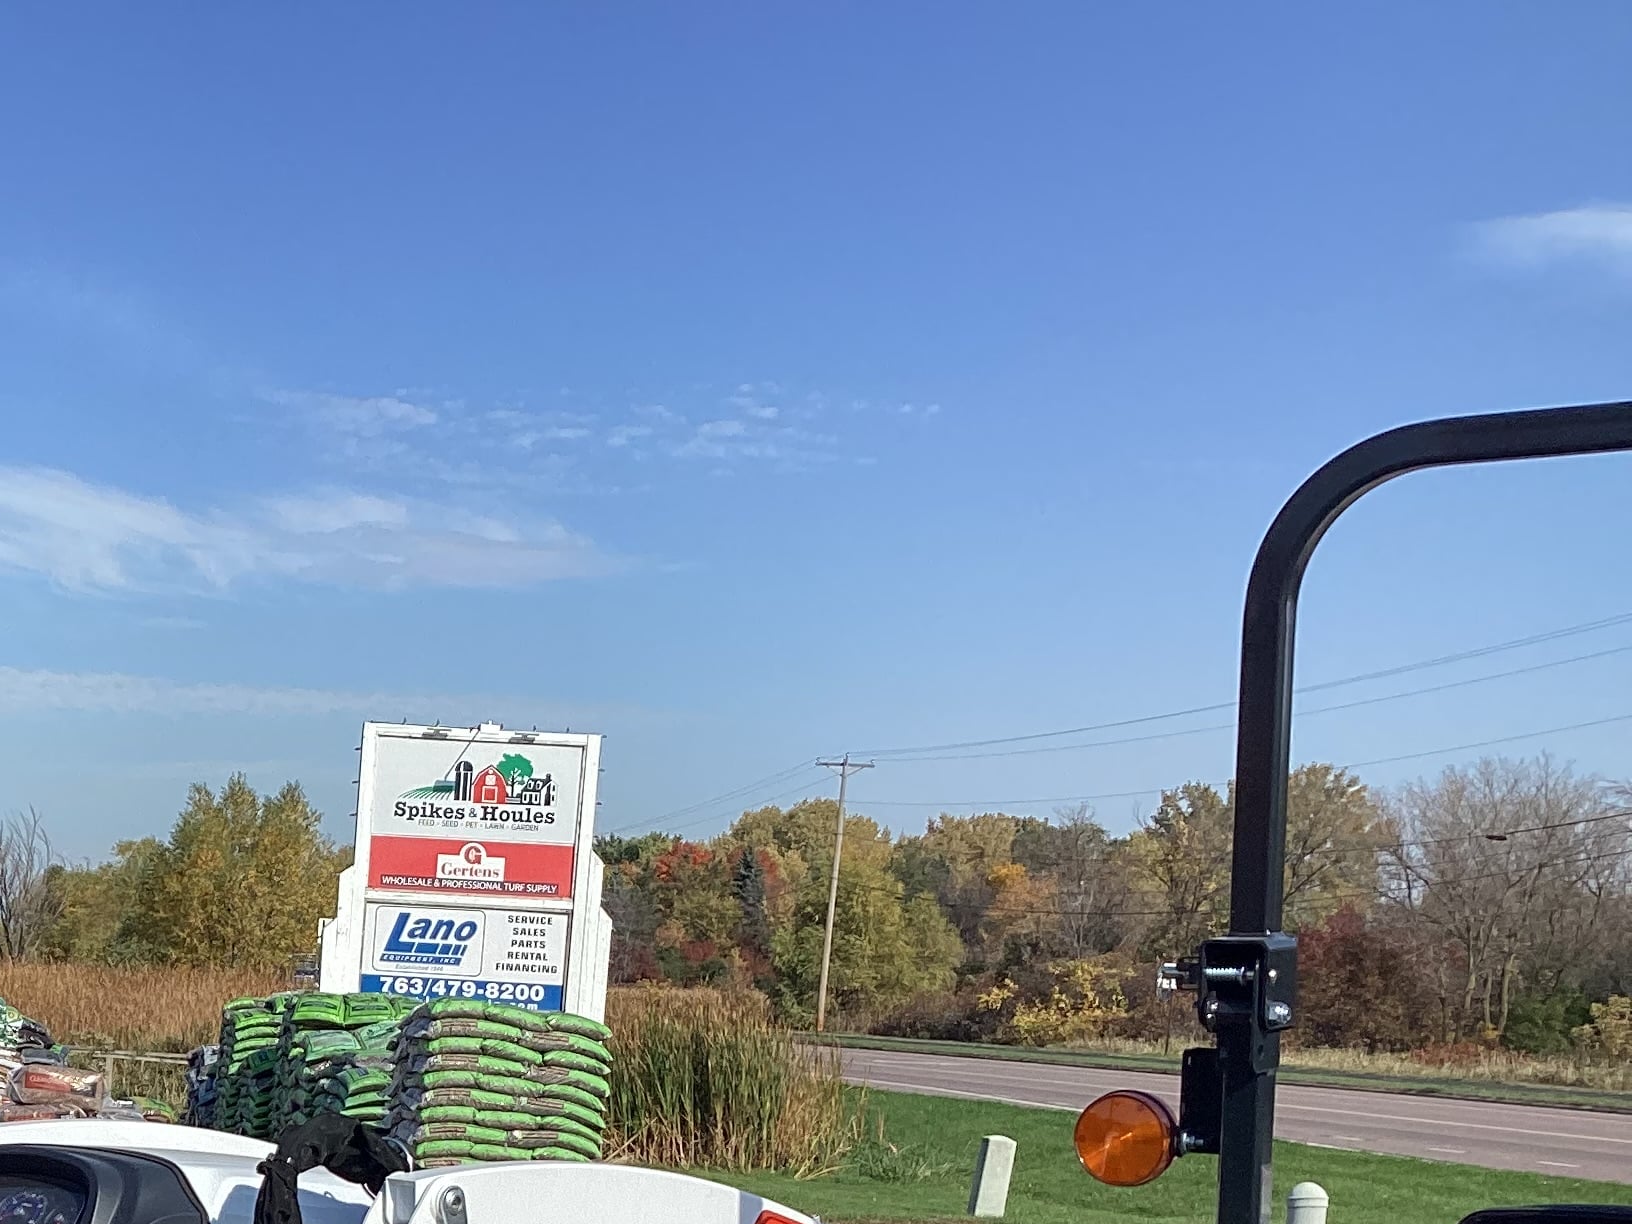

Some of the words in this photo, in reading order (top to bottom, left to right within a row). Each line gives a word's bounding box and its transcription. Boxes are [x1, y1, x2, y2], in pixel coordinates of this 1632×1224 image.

[394, 801, 465, 821] Spikes
[468, 808, 478, 818] &
[480, 806, 556, 824] Houles
[418, 819, 435, 827] FEED
[441, 820, 459, 828] SEED
[465, 821, 478, 829] PET
[484, 822, 505, 830] LAWN
[511, 823, 539, 832] GARDEN
[441, 862, 501, 879] Gertens
[382, 876, 433, 887] WHOLESALE
[433, 877, 441, 887] &
[441, 879, 502, 891] PROFESSIONAL
[503, 882, 524, 892] TURF
[526, 884, 558, 894] SUPPLY
[507, 915, 553, 926] SERVICE
[384, 912, 478, 953] Lano
[512, 927, 547, 937] SALES
[511, 939, 546, 949] PARTS
[507, 951, 549, 961] RENTAL
[495, 962, 558, 974] FINANCING
[379, 976, 545, 1002] 763/479-8200
